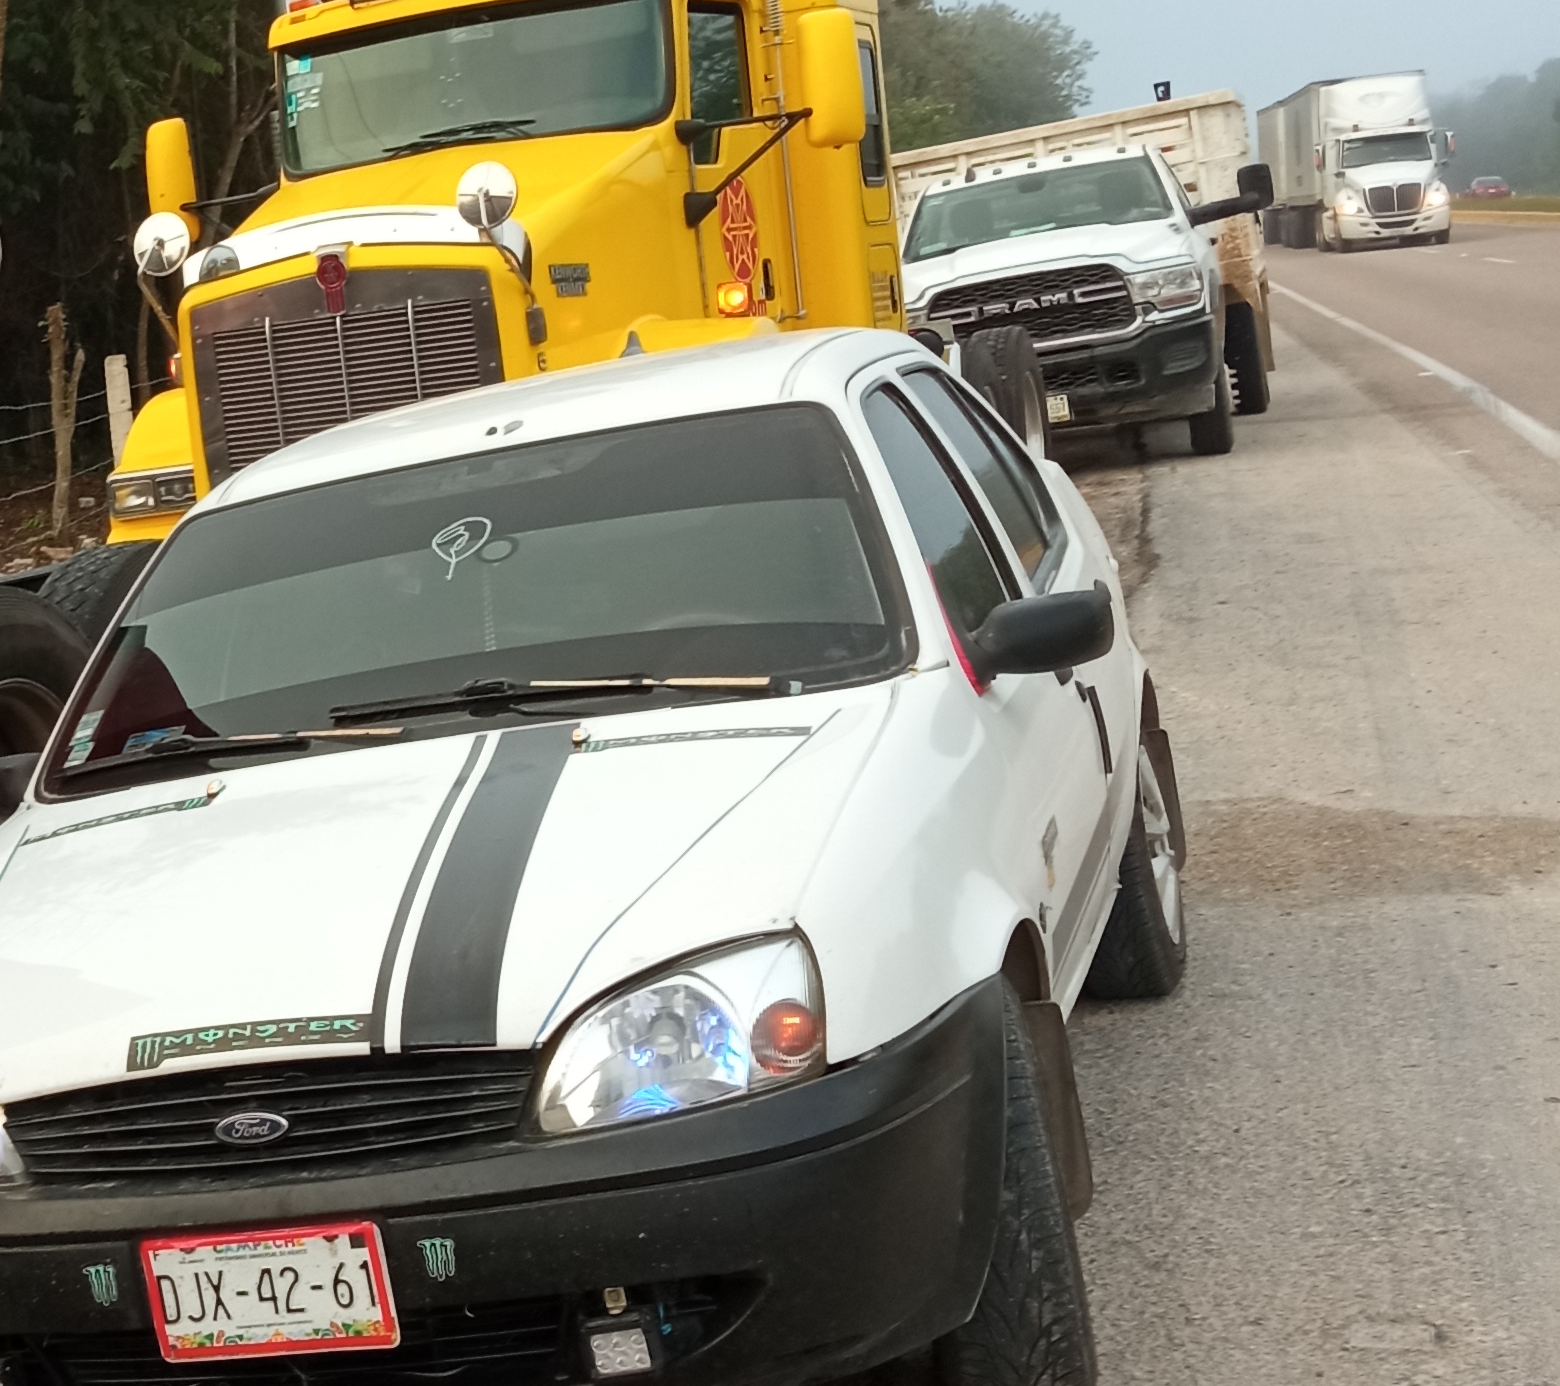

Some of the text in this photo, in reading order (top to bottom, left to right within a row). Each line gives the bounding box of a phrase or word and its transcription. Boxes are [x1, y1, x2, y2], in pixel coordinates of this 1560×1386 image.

[982, 292, 1068, 316] RAM
[163, 1018, 363, 1047] MONSTER
[231, 1118, 271, 1139] Ford
[157, 1259, 378, 1325] DJX-42-61
